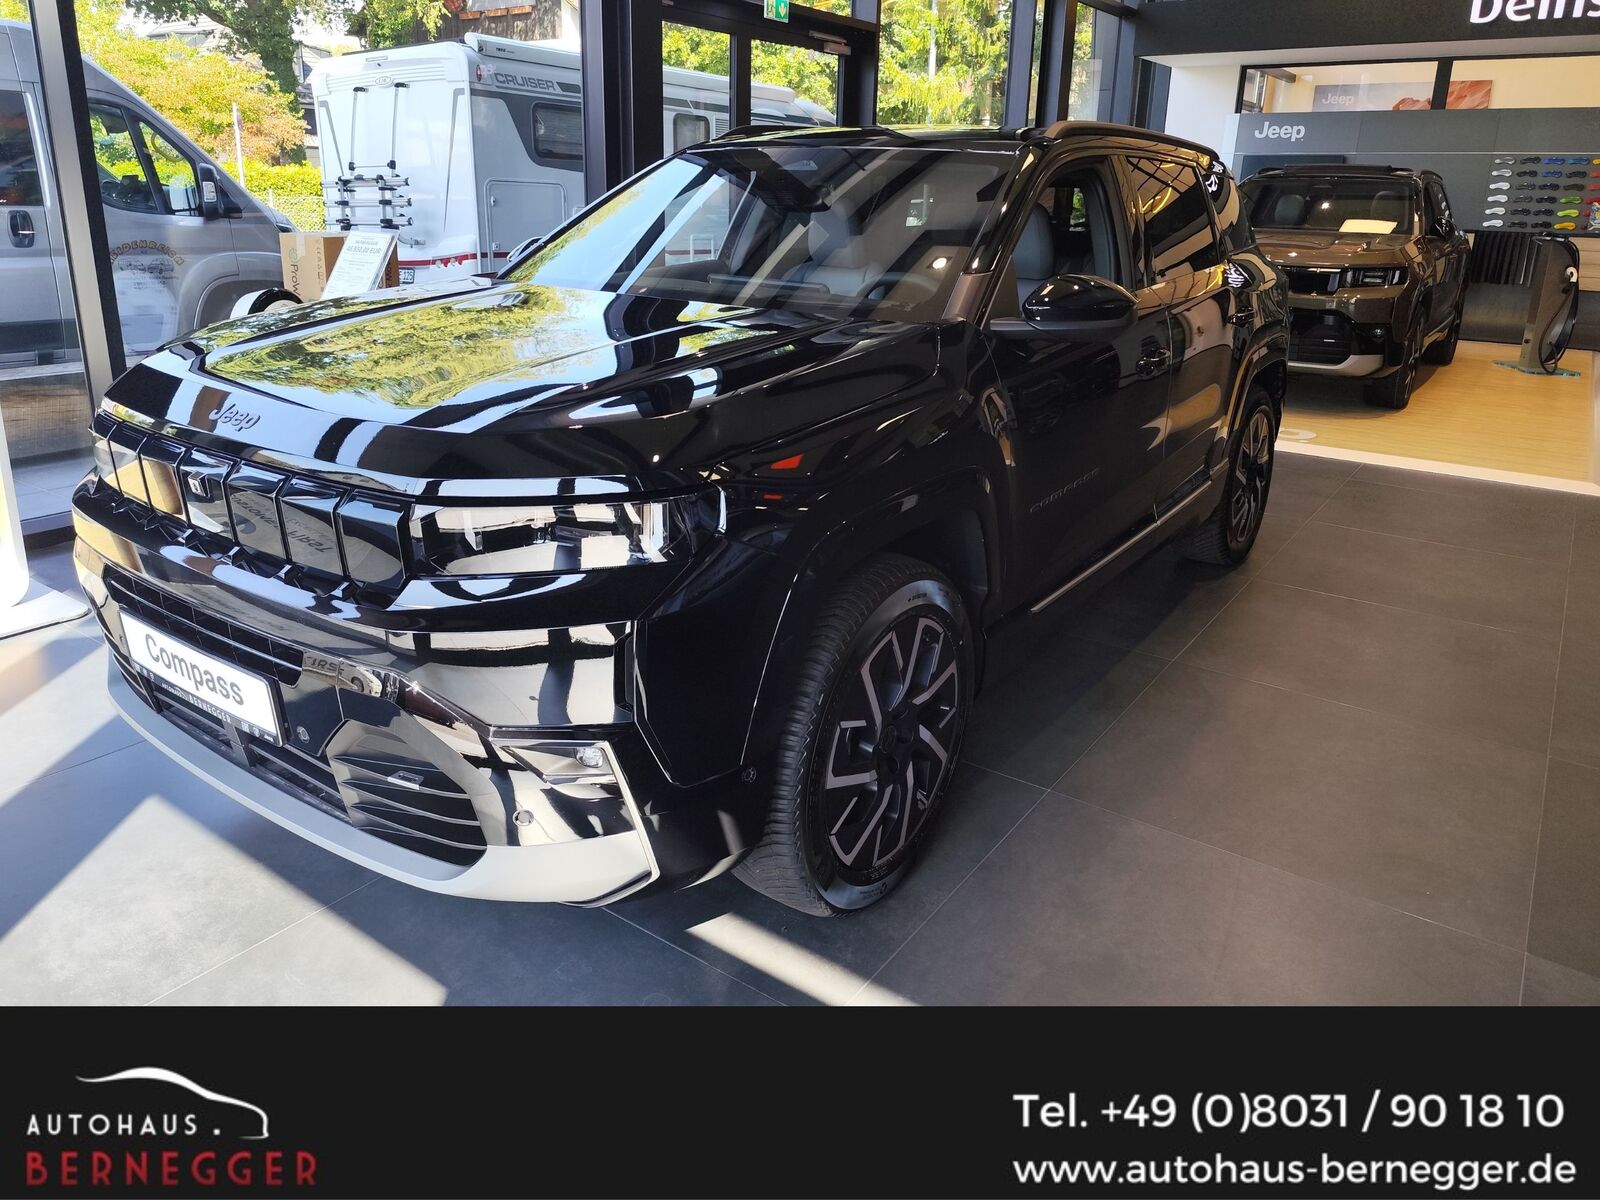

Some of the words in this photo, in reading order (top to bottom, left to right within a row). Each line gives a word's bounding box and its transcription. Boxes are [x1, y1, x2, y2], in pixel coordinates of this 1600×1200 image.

[494, 72, 557, 91] CRUISER
[1322, 93, 1354, 106] Jeep
[1254, 121, 1306, 142] Jeep
[208, 403, 261, 432] Jeep
[145, 633, 245, 706] Compass
[188, 694, 232, 724] BERNEGGER
